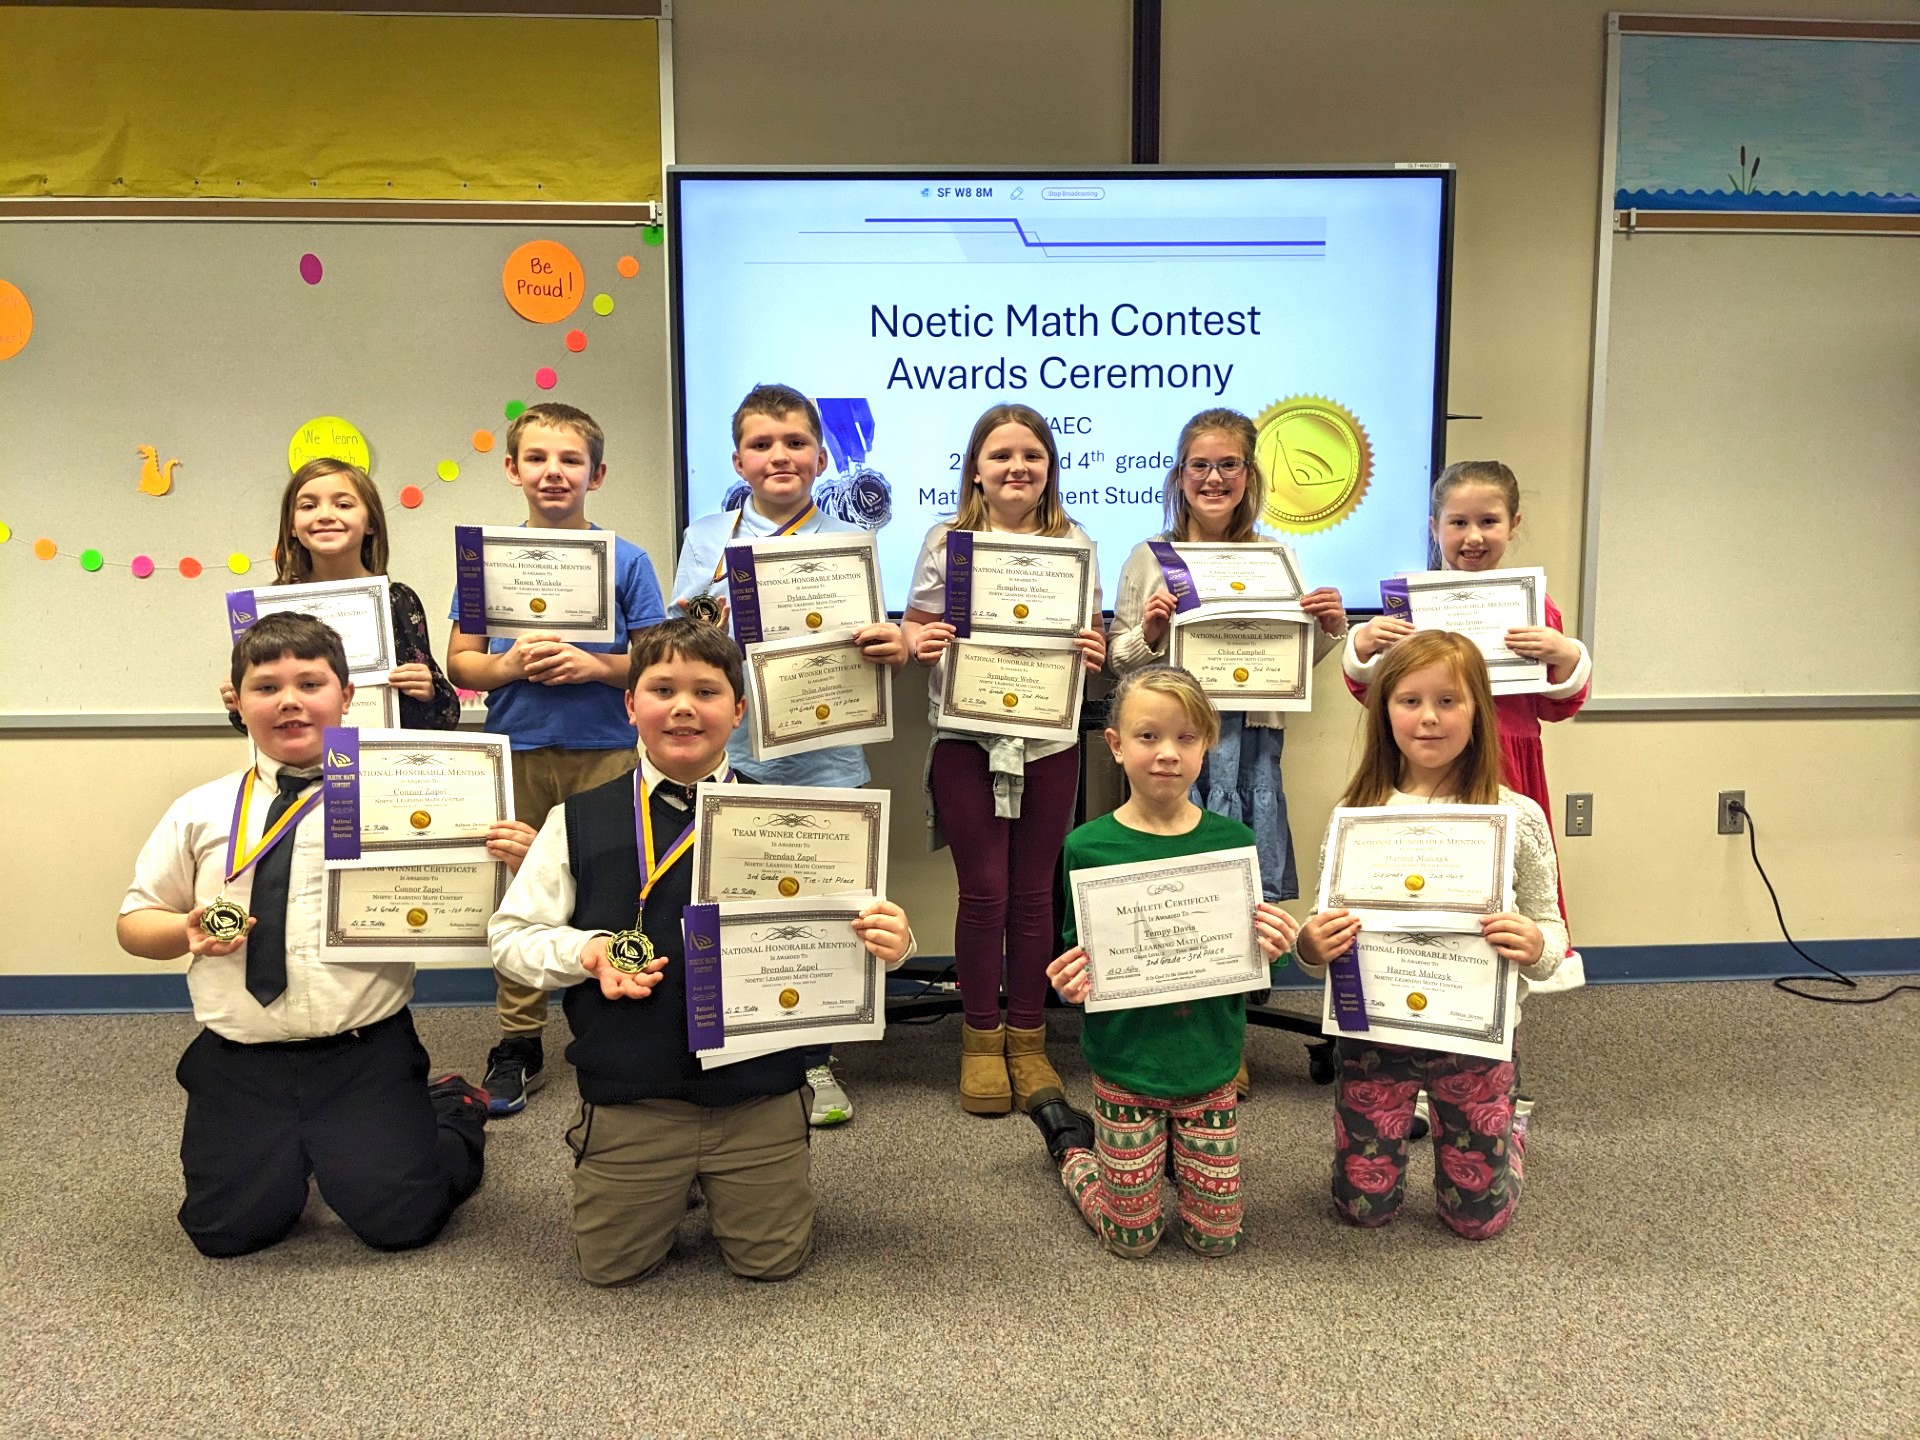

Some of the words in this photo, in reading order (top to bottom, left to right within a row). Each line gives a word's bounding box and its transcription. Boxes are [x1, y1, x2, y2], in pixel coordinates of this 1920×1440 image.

[937, 188, 951, 197] SF
[955, 188, 972, 197] W8
[976, 188, 992, 197] 8M
[531, 258, 553, 274] Be
[871, 304, 994, 337] Noetic
[1006, 304, 1098, 336] Math
[1111, 303, 1261, 336] Contest
[887, 357, 1027, 390] Awards
[1040, 356, 1233, 395] Ceremony
[303, 429, 320, 444] We
[332, 427, 358, 445] learn
[919, 488, 959, 505] Mat
[973, 566, 1004, 574] NATIONAL
[1006, 568, 1044, 577] HONORABLE
[757, 579, 790, 587] NATIONAL
[792, 576, 831, 584] HONORABLE
[997, 584, 1028, 592] Symphony
[808, 592, 837, 600] Anderson
[964, 654, 996, 664] NATIONAL
[997, 658, 1035, 667] HONORABLE
[1036, 662, 1066, 670] MENTION
[779, 674, 796, 682] TEAM
[798, 670, 823, 678] WINNER
[824, 663, 861, 674] CERTIFICATE
[987, 673, 1018, 682] Symphony
[1020, 675, 1039, 684] Weber
[732, 828, 757, 838] TEAM
[759, 829, 794, 839] WINNER
[795, 831, 850, 841] CERTIFICATE
[764, 852, 796, 861] Brendan
[797, 853, 817, 862] Zapel
[761, 873, 779, 881] Grade
[803, 876, 816, 884] Tie
[365, 905, 377, 913] 3rd
[1116, 902, 1163, 916] MATHLETE
[1165, 895, 1220, 909] CERTIFICATE
[1155, 912, 1180, 921] AWARDED
[1144, 928, 1171, 939] Tempy
[1173, 924, 1196, 933] Davis
[721, 947, 763, 955] NATIONAL
[765, 943, 816, 952] HONORABLE
[1109, 946, 1138, 956] NOETIC
[1139, 941, 1175, 952] LEARNING
[1176, 937, 1199, 948] MATH
[1201, 933, 1233, 944] CONTEST
[1146, 957, 1159, 966] 2nd
[1160, 955, 1180, 965] Grade
[1188, 952, 1201, 961] 3rd
[1203, 947, 1224, 957] Place
[1396, 947, 1448, 960] HONORABLE
[1449, 953, 1489, 966] MENTION
[761, 964, 794, 974] Brendan
[796, 963, 818, 973] Zapel
[1387, 966, 1417, 977] Harriet
[1419, 970, 1452, 981] Malczyk
